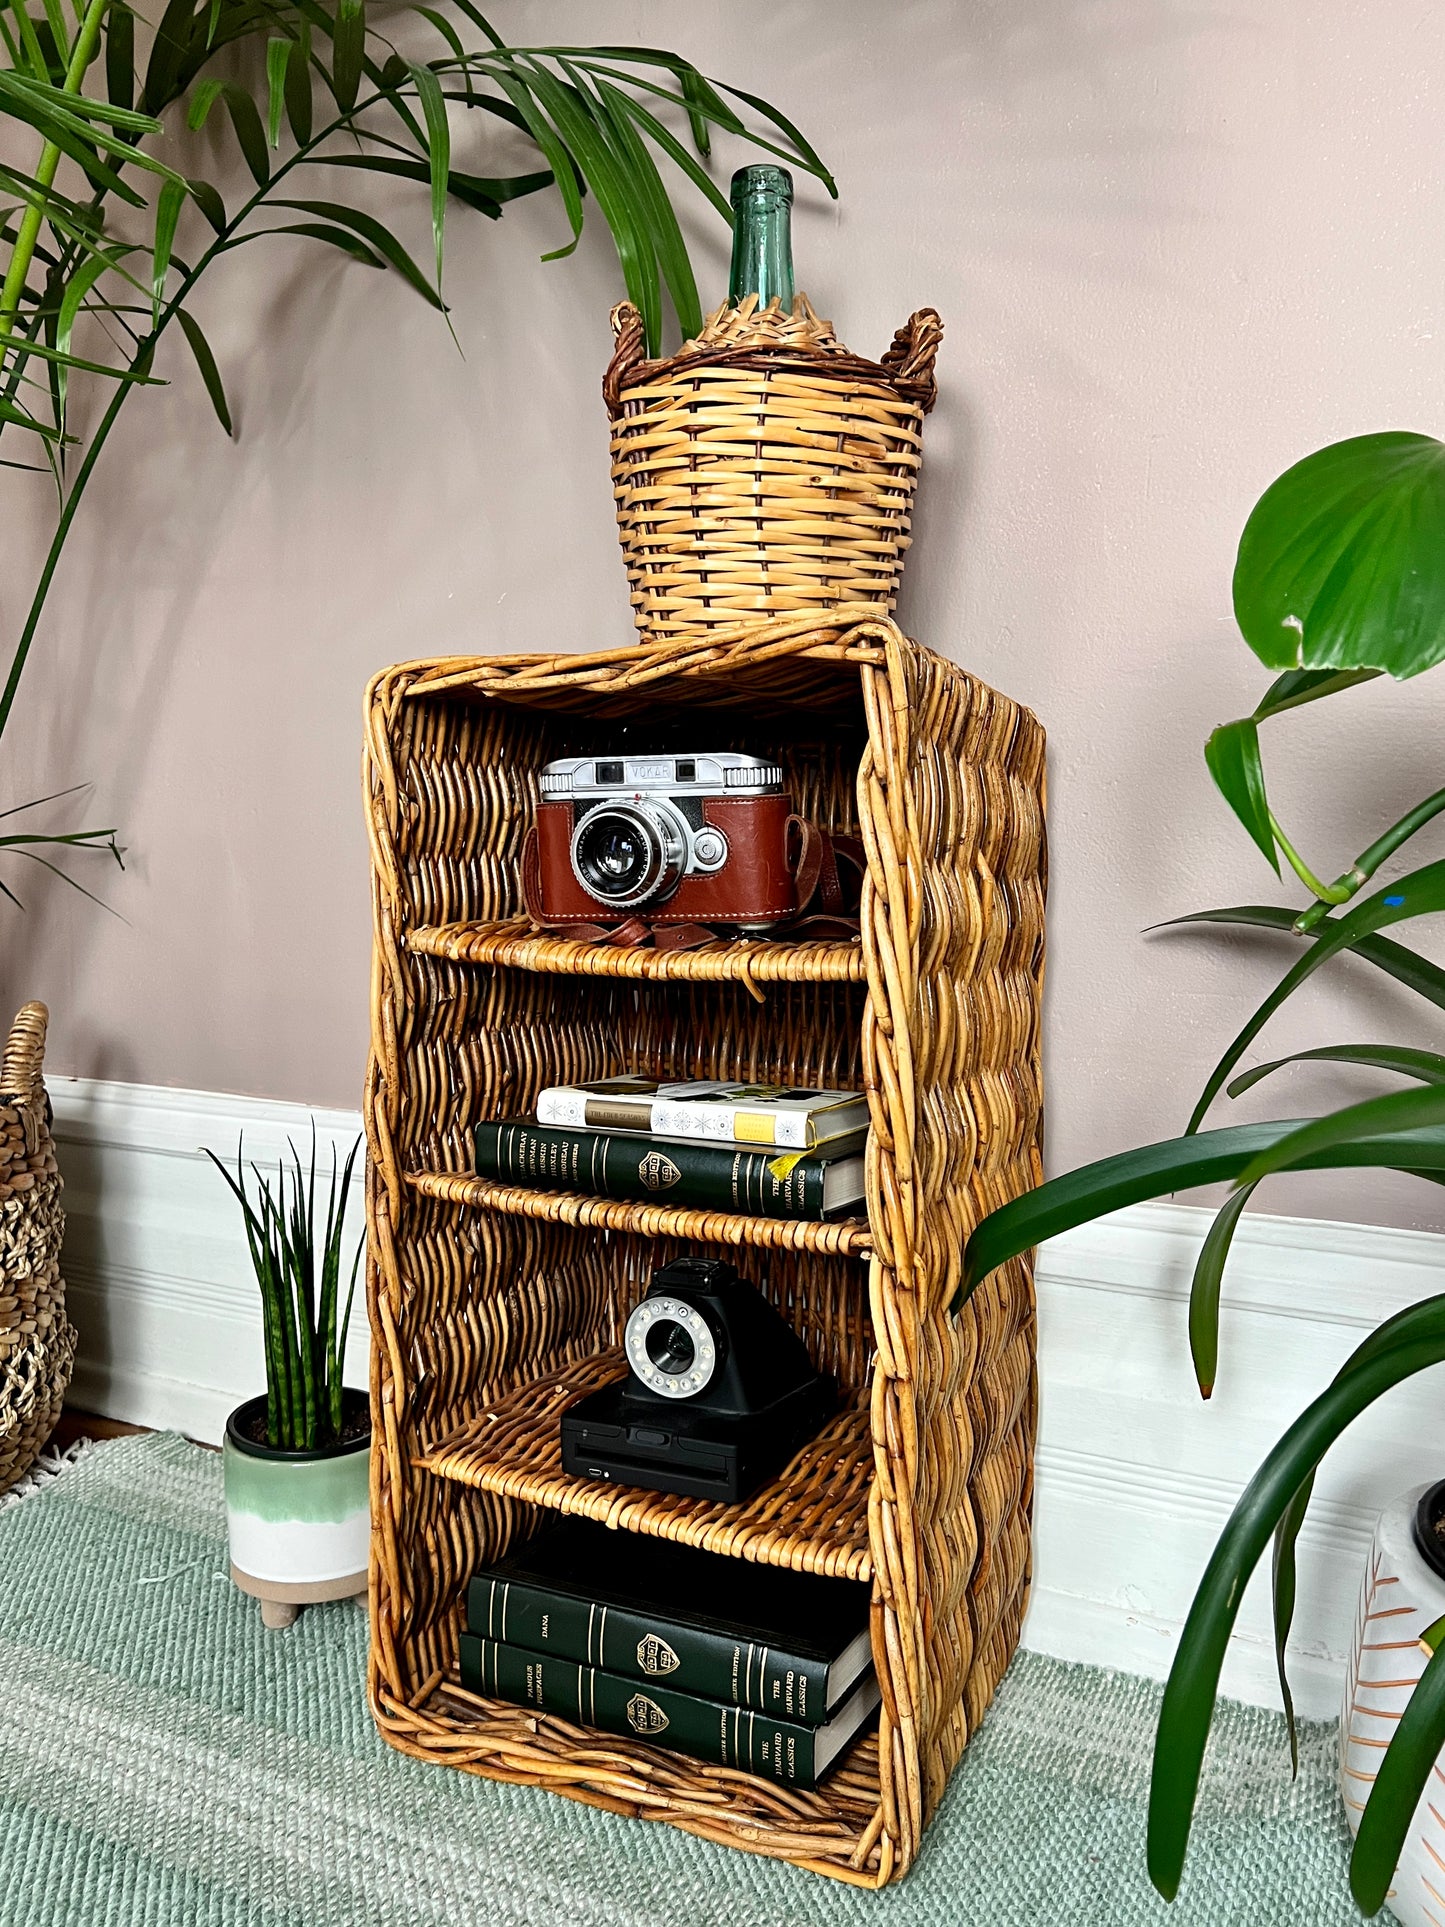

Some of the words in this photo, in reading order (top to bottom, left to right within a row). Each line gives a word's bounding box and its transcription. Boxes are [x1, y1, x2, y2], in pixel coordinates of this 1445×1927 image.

[632, 766, 671, 779] VOKAR
[529, 1138, 537, 1176] NEWMAN
[550, 1142, 558, 1177] HUXLEY
[560, 1141, 569, 1180] THOREAU
[732, 1152, 741, 1181] EDITION
[784, 1169, 794, 1210] HARVAR
[797, 1169, 807, 1211] CLASSICS
[541, 1614, 549, 1638] DANA
[732, 1646, 741, 1677] EDITION
[773, 1679, 781, 1699] THE
[785, 1670, 794, 1714] HARVARD
[798, 1674, 807, 1717] CLASSICS
[761, 1741, 769, 1760] THE
[774, 1732, 783, 1776] HARVARD
[787, 1737, 796, 1778] CLASSICS
